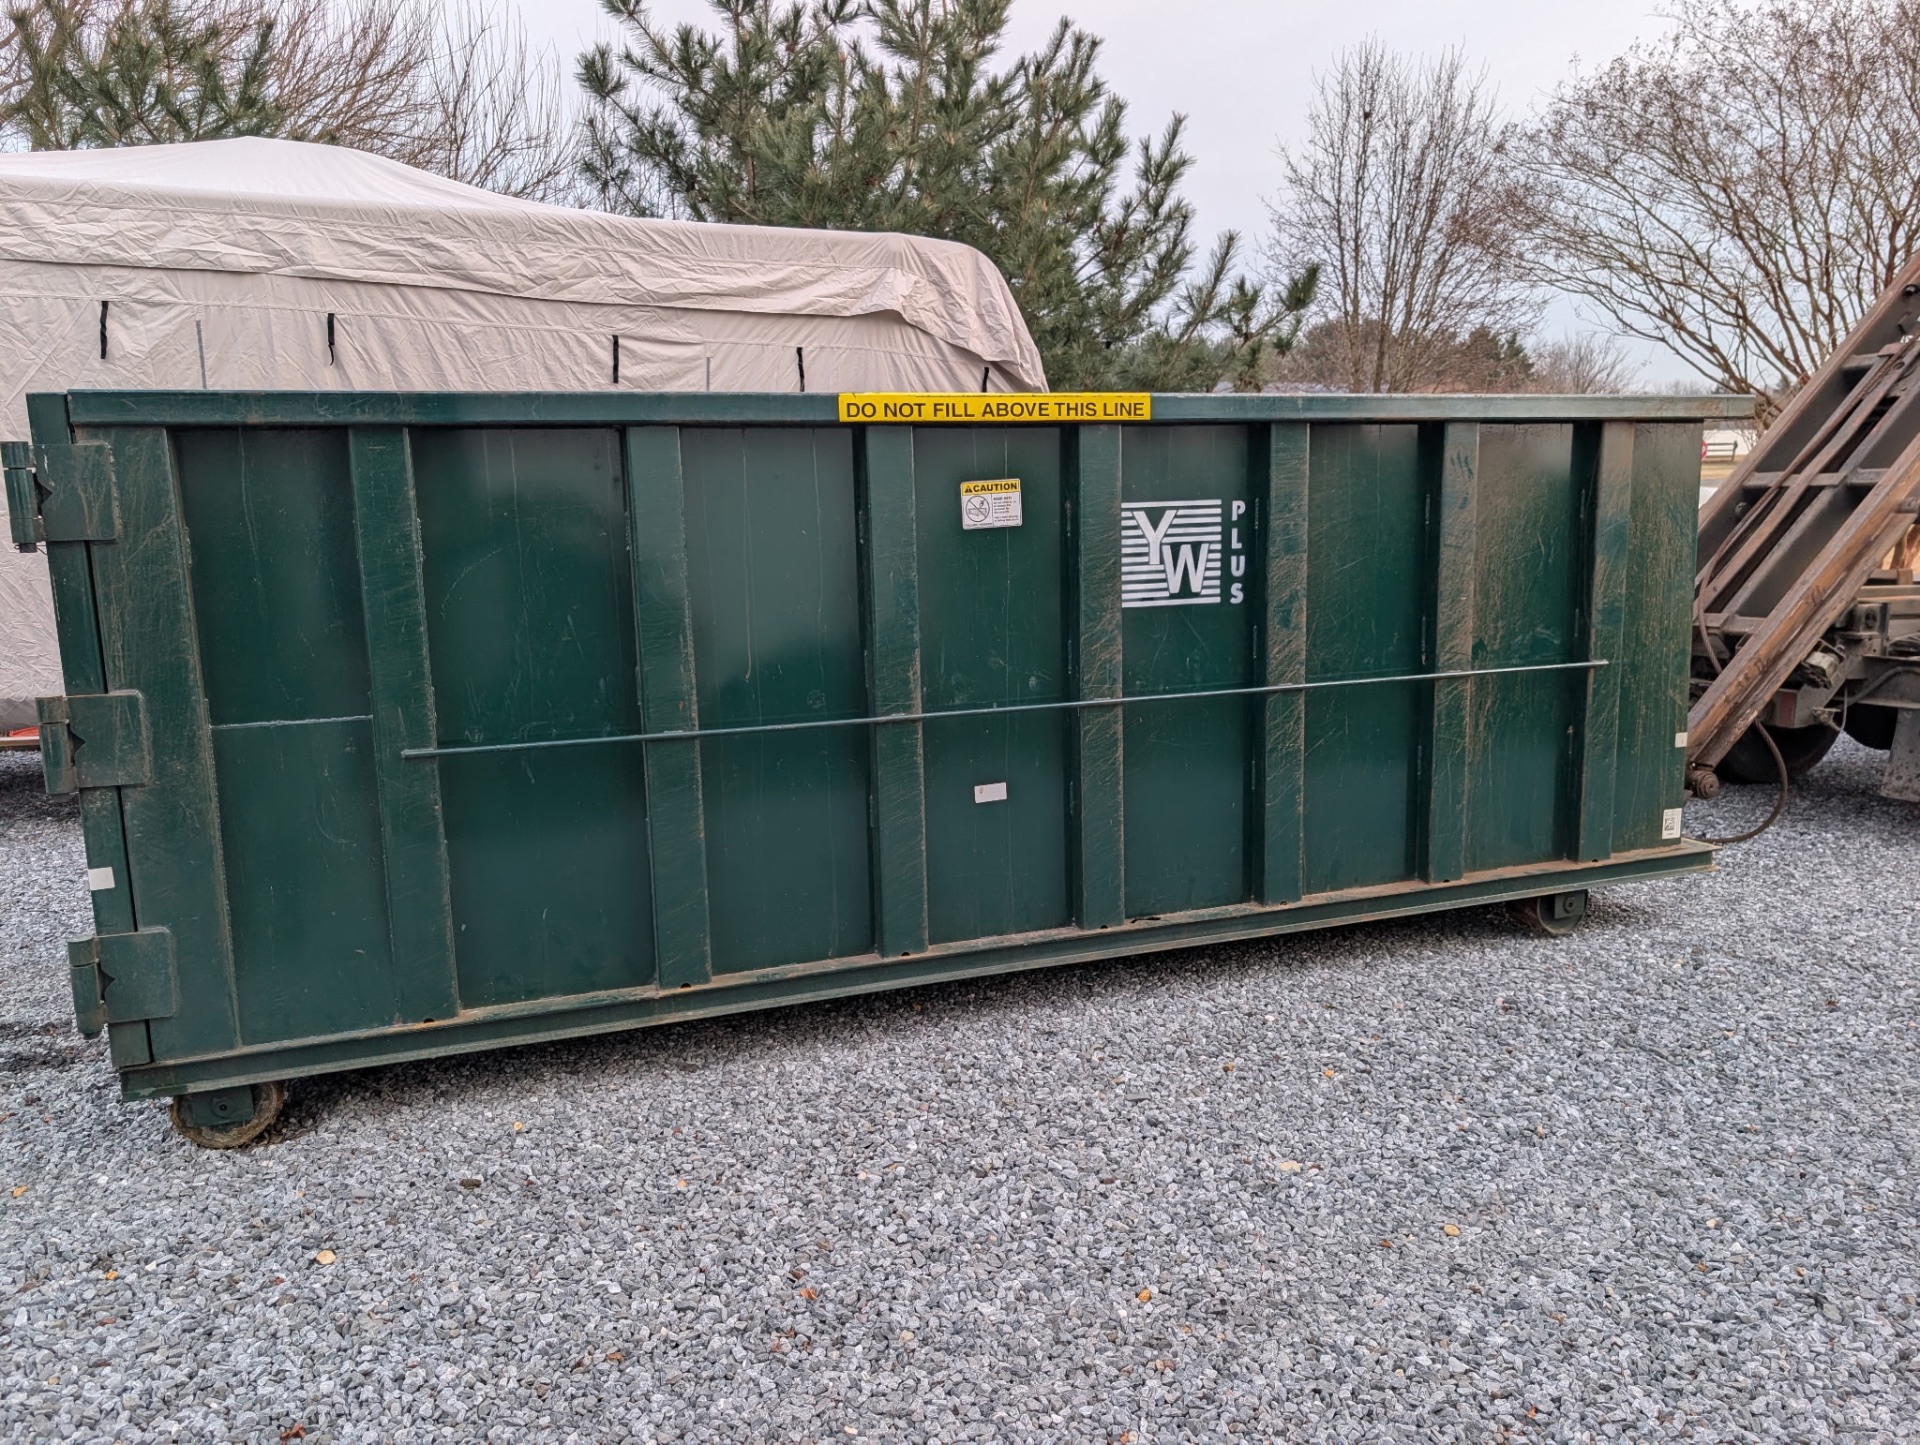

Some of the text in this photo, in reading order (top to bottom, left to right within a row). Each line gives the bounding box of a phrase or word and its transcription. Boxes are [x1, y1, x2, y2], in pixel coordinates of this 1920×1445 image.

[846, 402, 1145, 418] DO NOT FILL ABOVE THIS LINE
[972, 482, 1018, 493] CAUTION
[1230, 500, 1246, 604] PLUS
